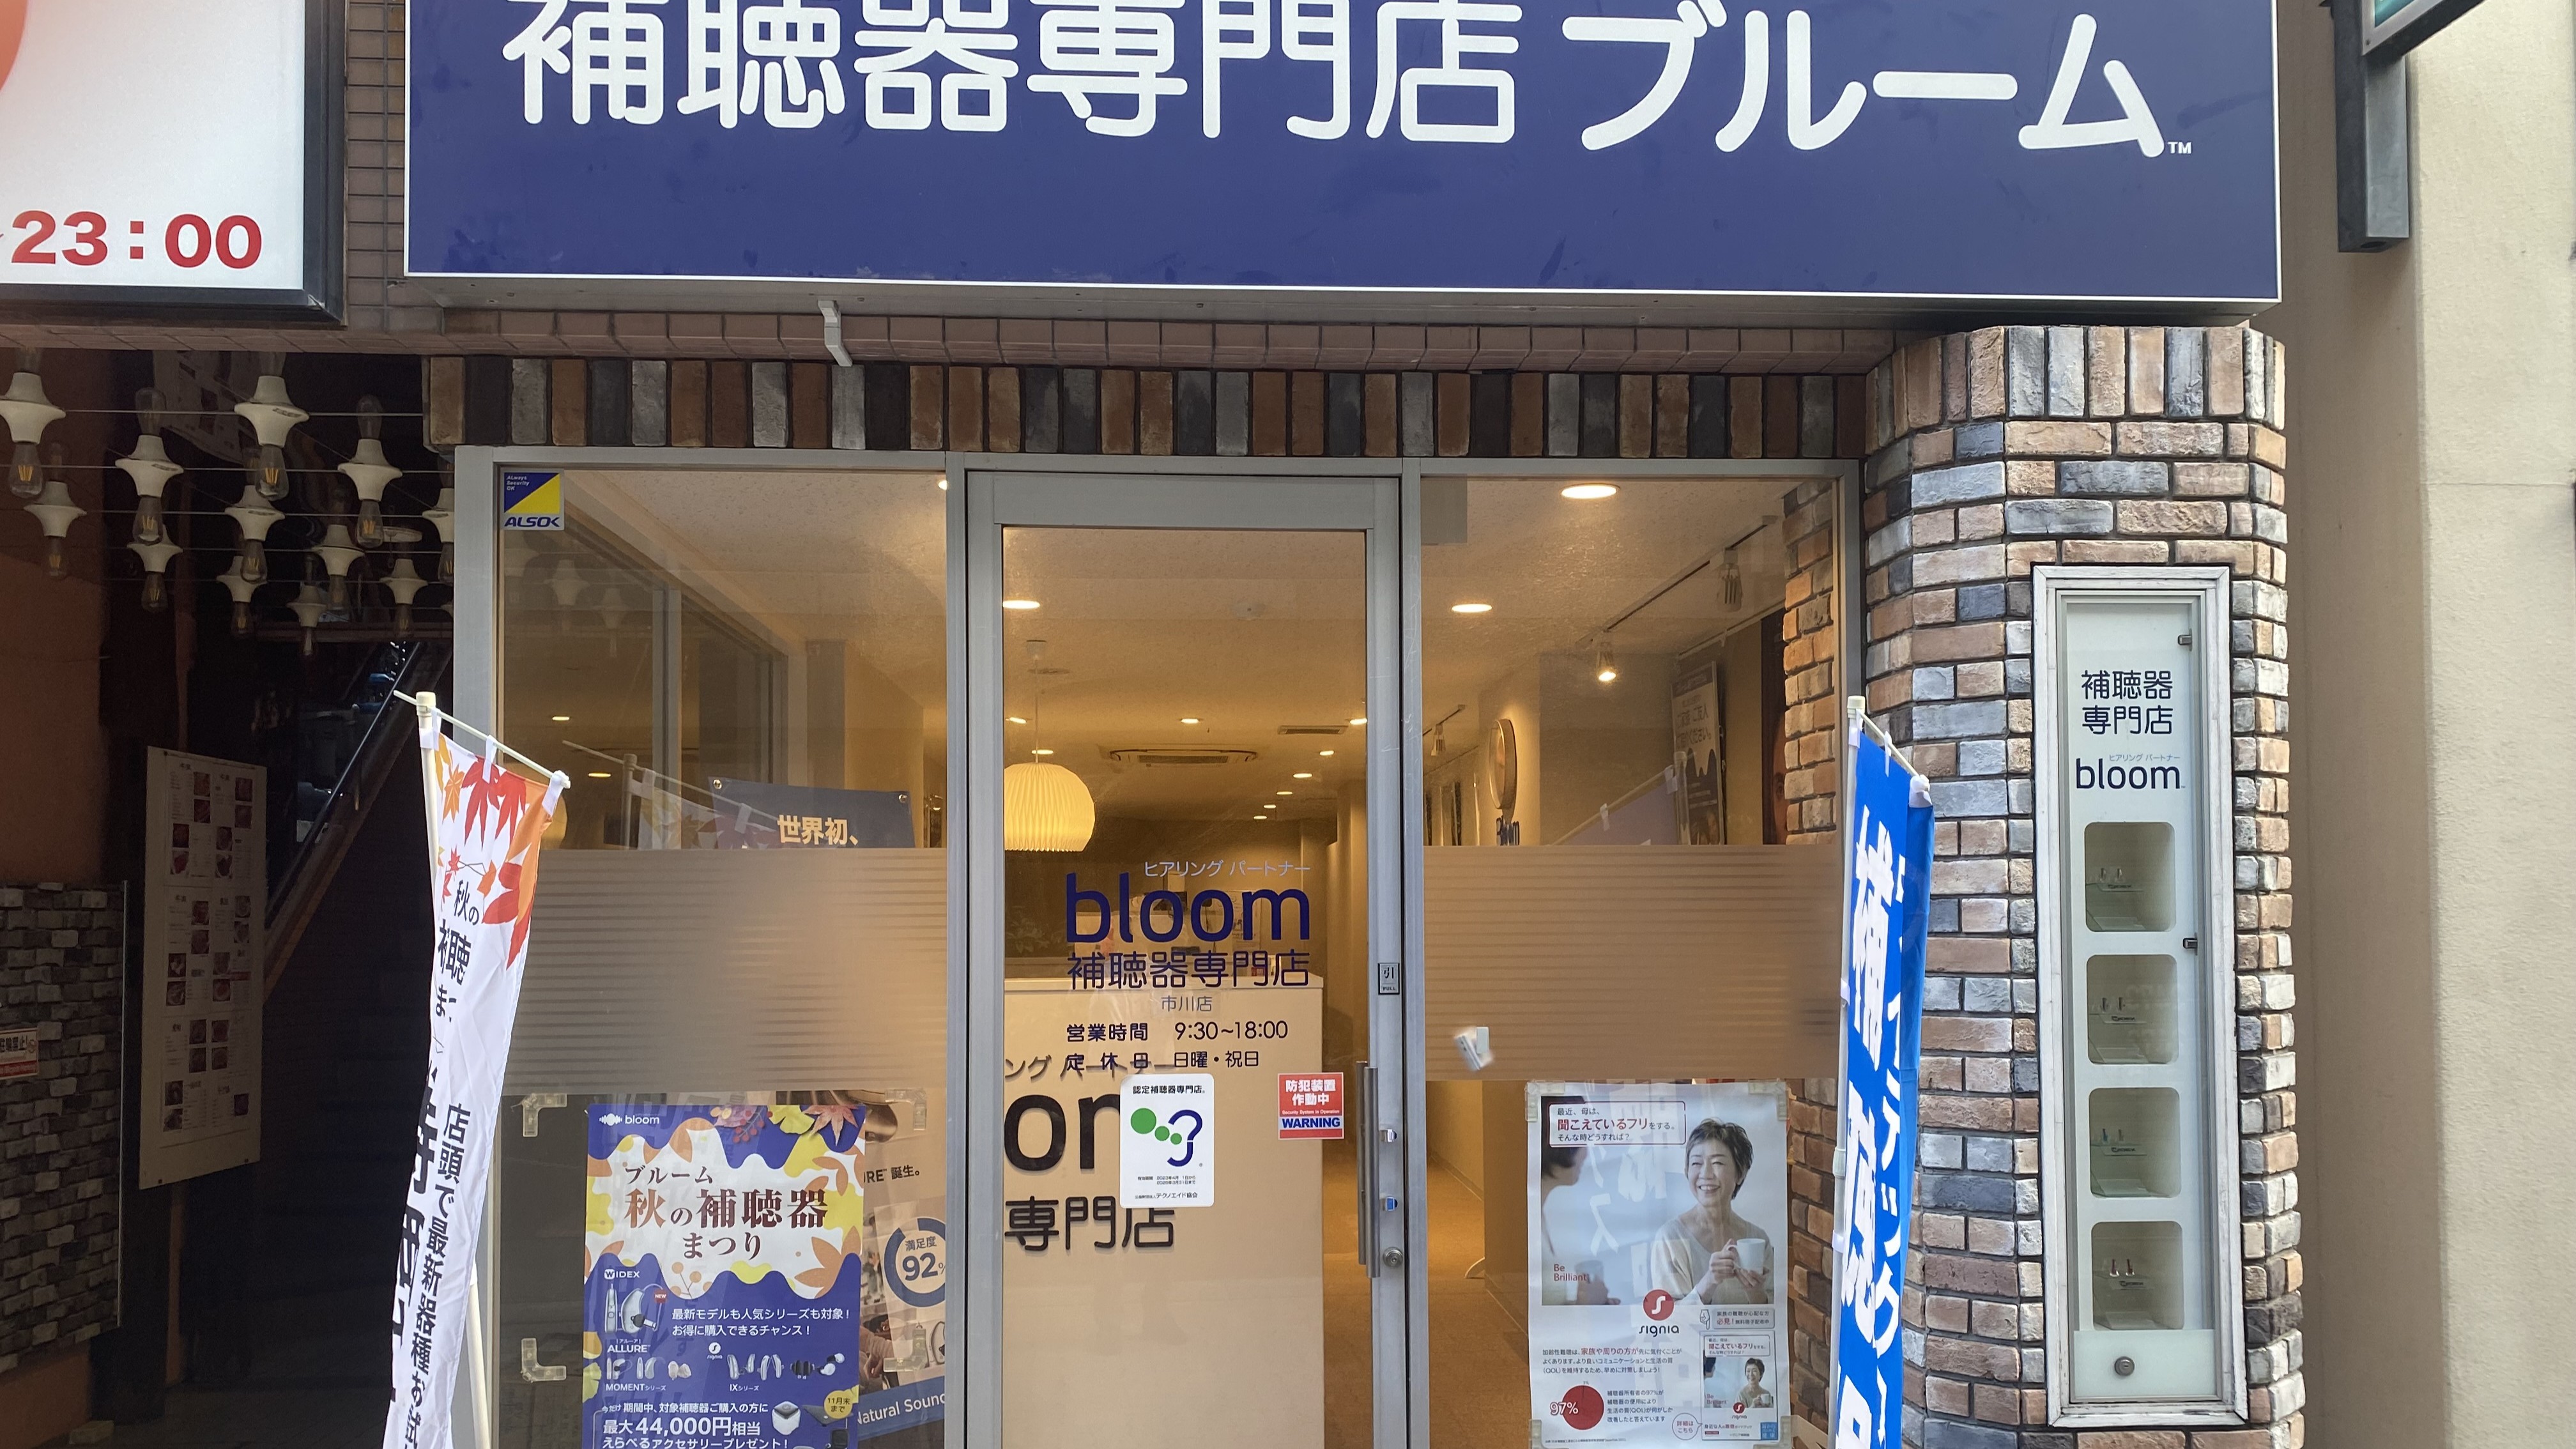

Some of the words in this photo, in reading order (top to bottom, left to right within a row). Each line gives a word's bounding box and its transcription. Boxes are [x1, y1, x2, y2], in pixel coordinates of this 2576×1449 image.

[503, 0, 1522, 142] 補聴器専門店
[1563, 0, 2164, 157] ブルーム
[504, 516, 560, 528] ALSOK
[2081, 670, 2173, 700] 補聴器
[2082, 705, 2174, 735] 専門店
[2076, 758, 2181, 790] bloom
[777, 815, 859, 845] 世界初、
[1144, 861, 1223, 878] ヒアリング
[1229, 860, 1311, 877] パートナー
[454, 879, 480, 926] 秋の
[1066, 872, 1310, 944] bloom
[1067, 948, 1310, 990] 補聴器専門店
[1160, 995, 1213, 1013] 市川店
[1066, 1023, 1149, 1043] 営業時間
[1173, 1050, 1259, 1069] 日曜・祝日
[1133, 1085, 1202, 1094] 認定補聴器専門店
[1285, 1079, 1336, 1092] 防犯装置
[1292, 1092, 1330, 1106] 作動中
[625, 1115, 660, 1124] bloom
[1282, 1117, 1340, 1129] WARNING
[624, 1165, 714, 1186] ブルーム
[891, 1165, 920, 1180] 誕生。
[624, 1187, 829, 1229] 秋の補聴器
[682, 1231, 761, 1261] まつり
[905, 1236, 937, 1252] 満足度
[604, 1269, 640, 1280] WIDEX
[1553, 1263, 1565, 1272] Be
[1638, 1325, 1680, 1338] signia
[827, 1397, 851, 1405] 11月末
[1549, 1401, 1579, 1416] 97%
